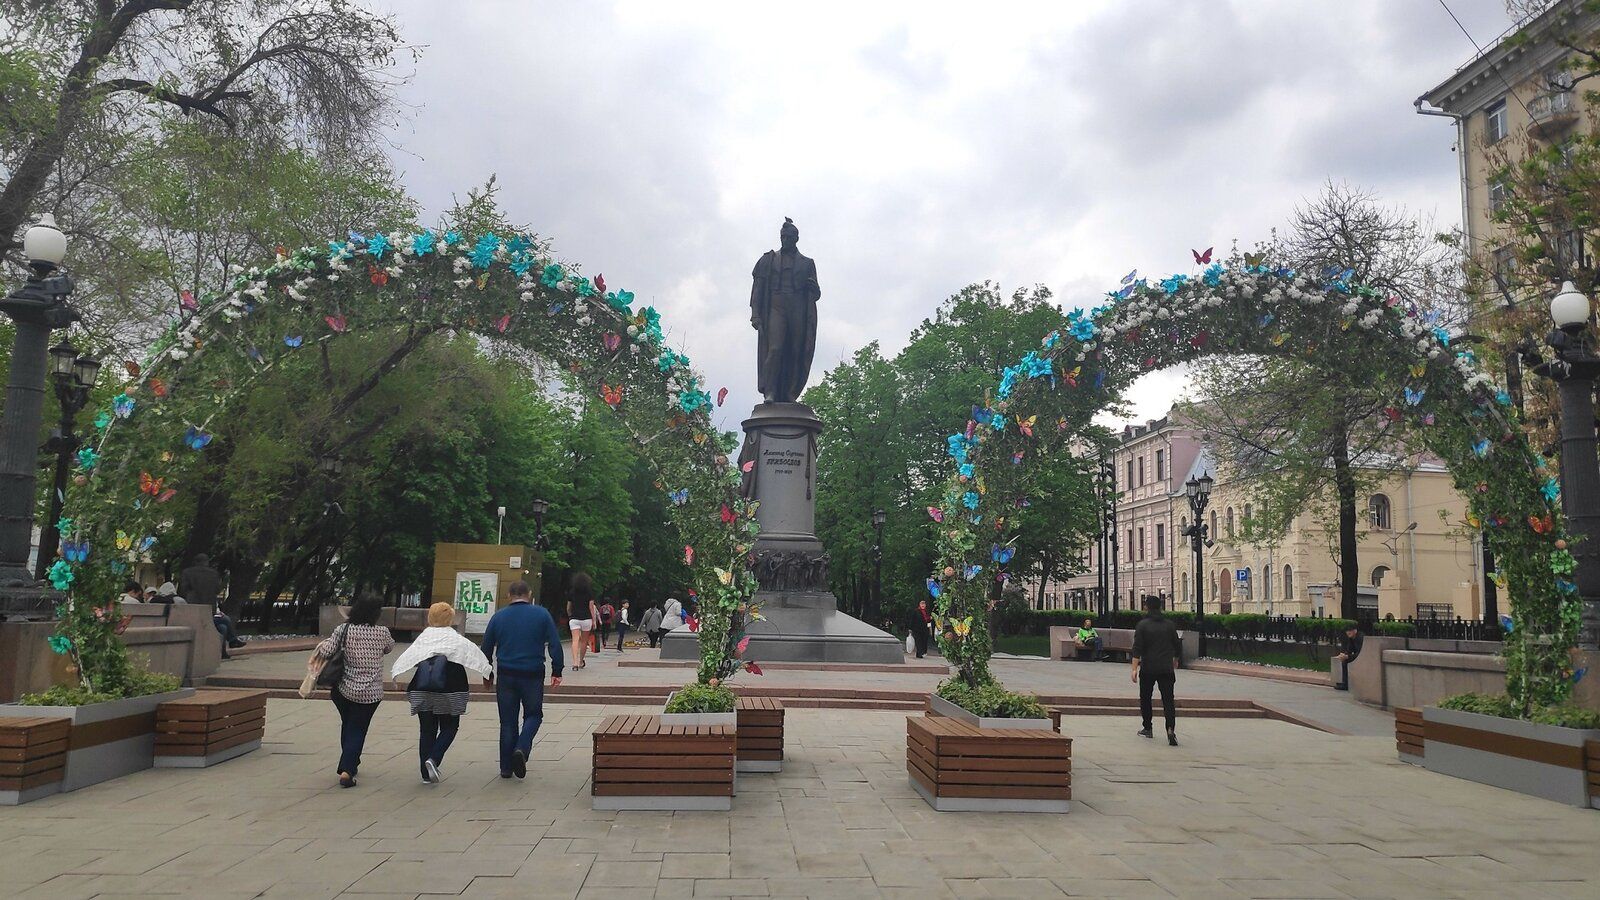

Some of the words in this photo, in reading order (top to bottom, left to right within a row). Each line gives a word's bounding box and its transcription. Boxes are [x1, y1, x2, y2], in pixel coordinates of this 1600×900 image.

[459, 579, 481, 591] РЕ
[459, 590, 494, 602] КЛА
[459, 602, 488, 613] МЫ
